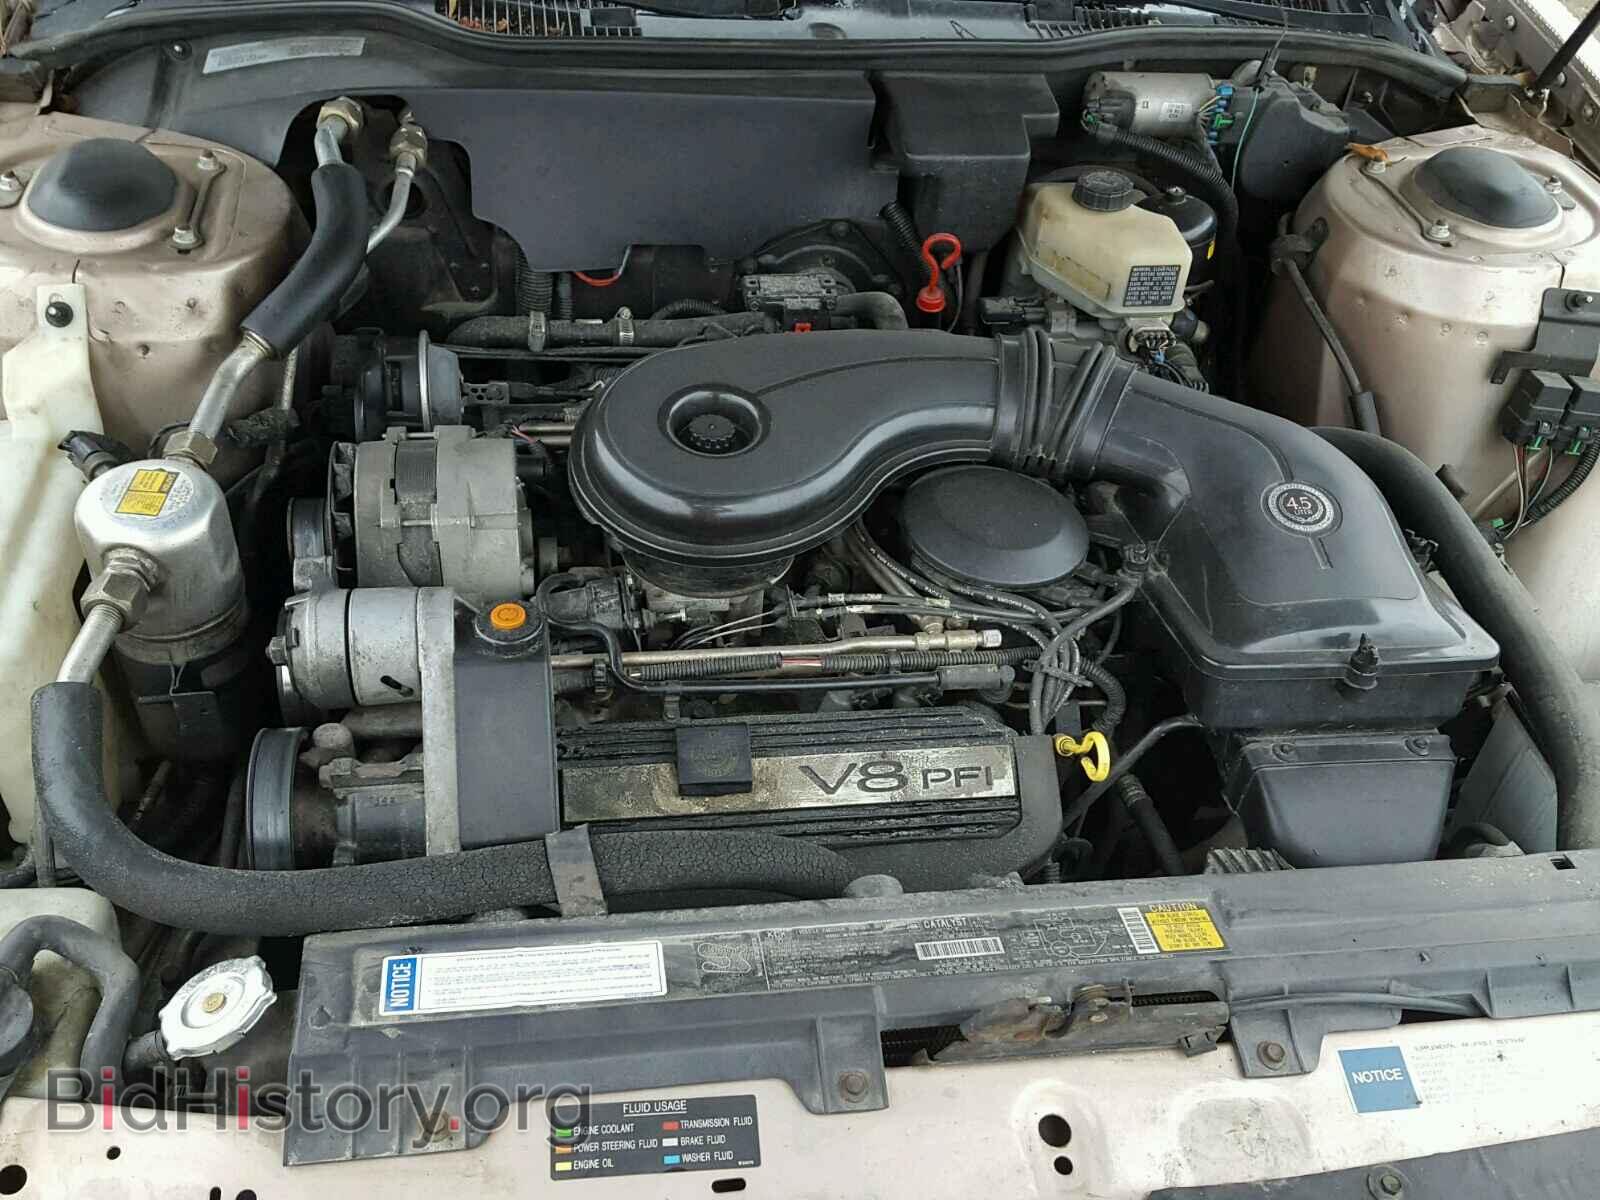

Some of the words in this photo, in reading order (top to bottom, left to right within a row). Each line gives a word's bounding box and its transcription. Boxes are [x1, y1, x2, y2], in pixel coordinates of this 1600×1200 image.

[1286, 496, 1312, 510] 4.5
[799, 760, 909, 795] V8
[922, 766, 994, 790] PFI
[1149, 902, 1201, 913] CAUTION
[923, 917, 967, 929] CATALYST
[390, 962, 411, 1007] NOTICE
[1352, 1067, 1404, 1085] NOTICE
[623, 1102, 651, 1114] FLUID
[654, 1100, 687, 1112] USAGE
[680, 1117, 730, 1129] TRANSMISSION
[733, 1116, 753, 1126] FLUID
[573, 1125, 599, 1136] ENGINE
[601, 1123, 635, 1134] COOLANT
[573, 1142, 599, 1153] POWER
[601, 1139, 636, 1151] STEERING
[639, 1138, 658, 1149] FLUID
[680, 1136, 704, 1146] BRAKE
[707, 1134, 726, 1145] FLUID
[682, 1152, 711, 1163] WASHER
[714, 1150, 734, 1161] FLUID
[573, 1159, 600, 1170] ENGINE
[602, 1158, 614, 1168] OIL
